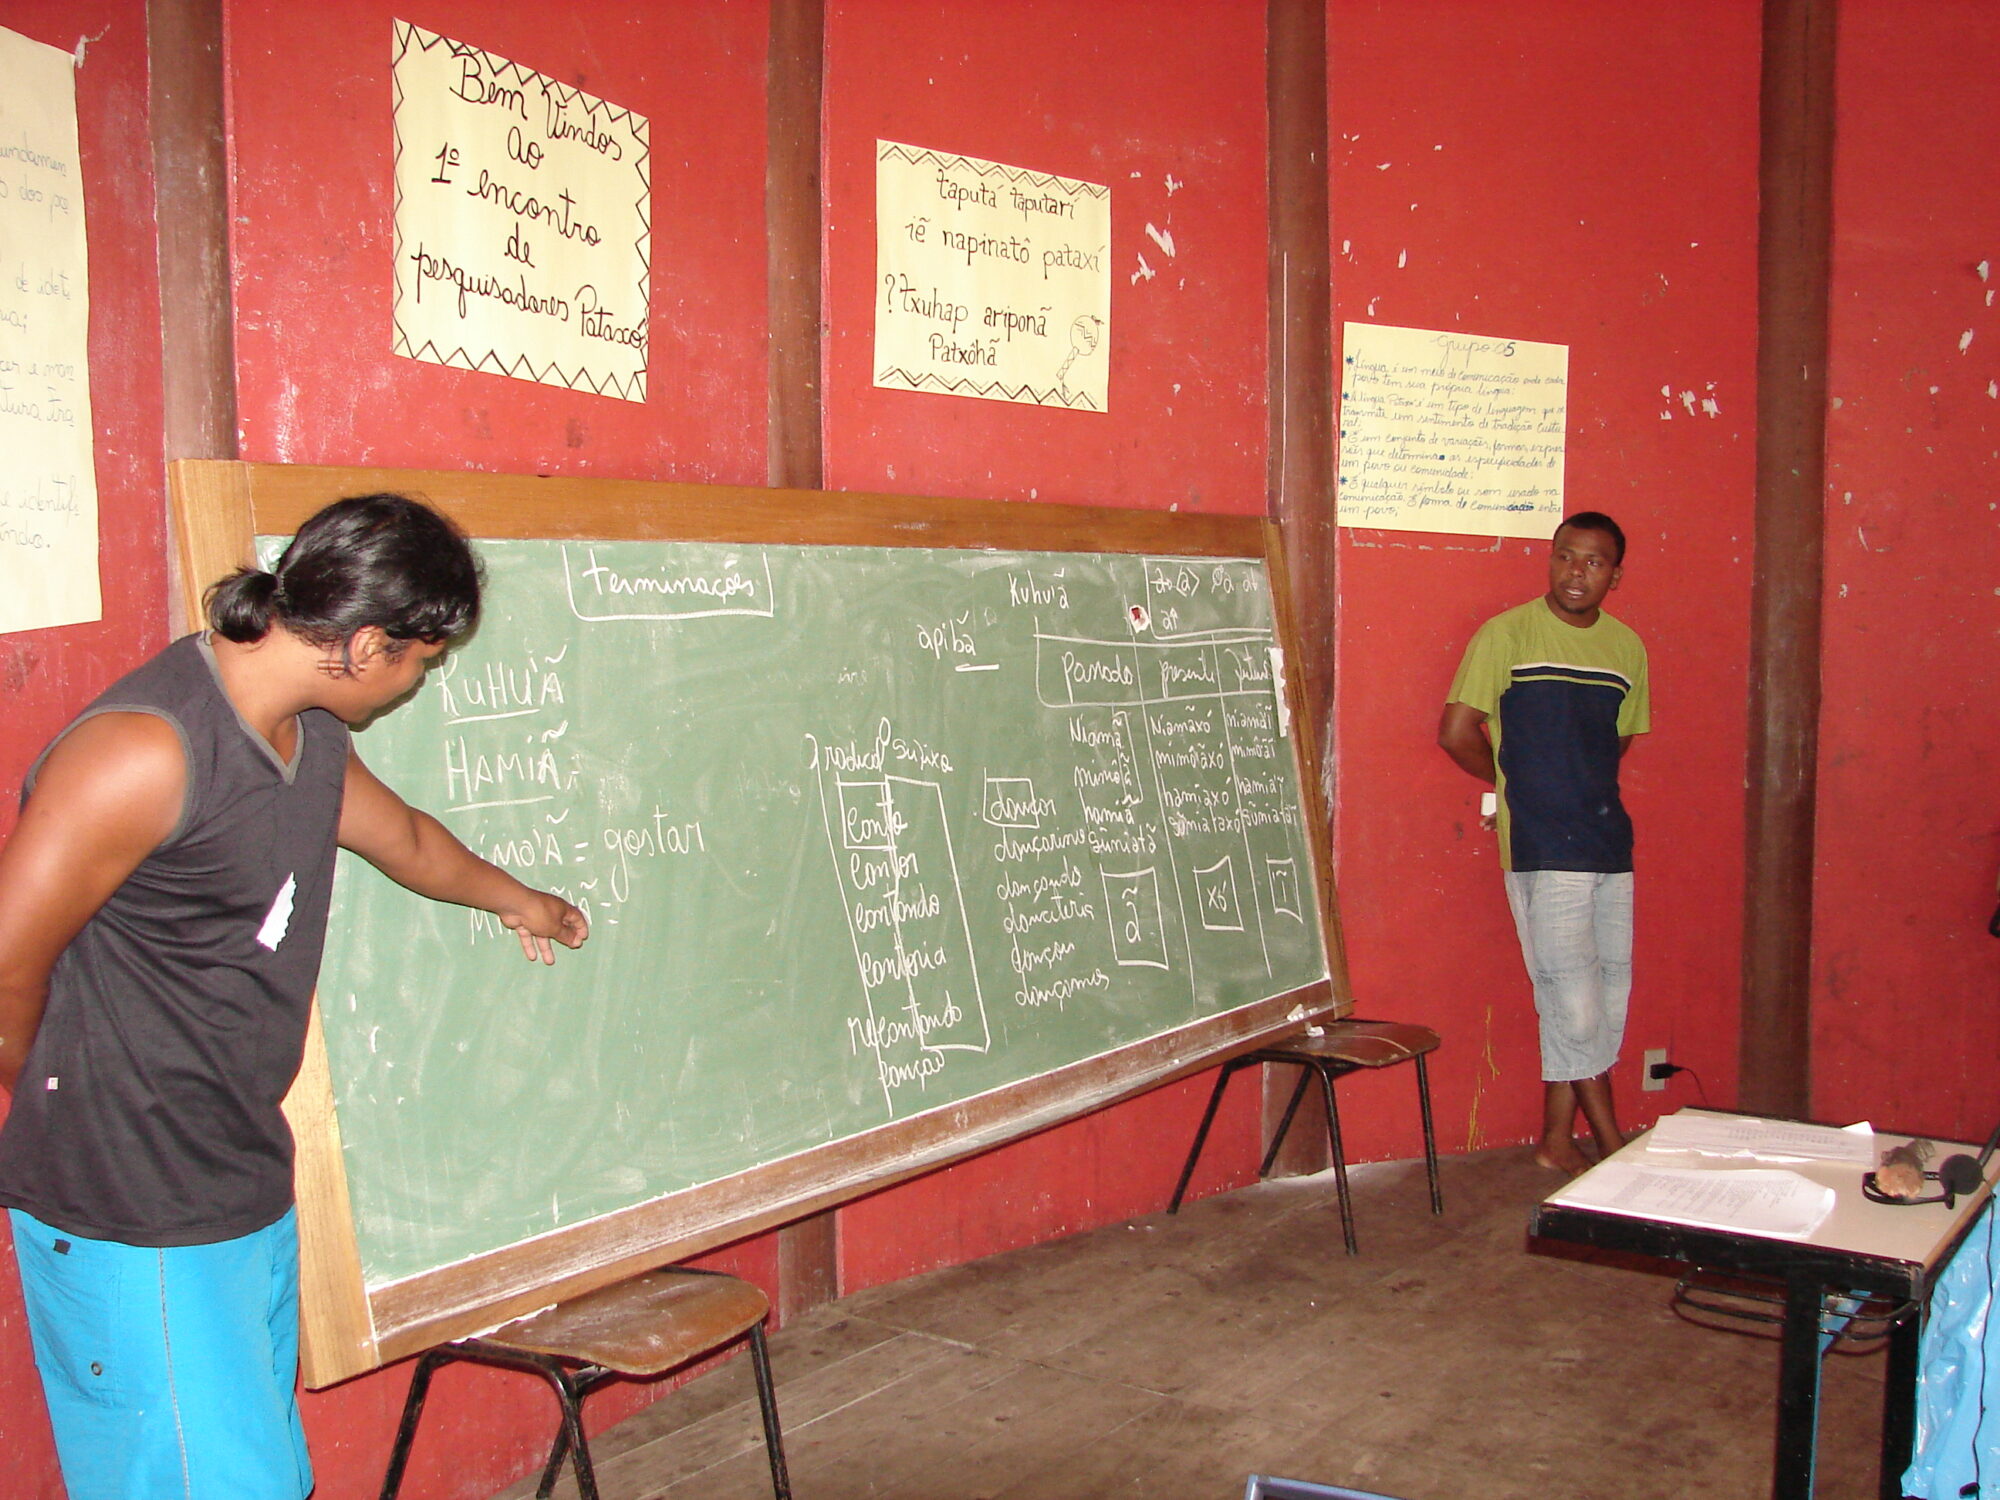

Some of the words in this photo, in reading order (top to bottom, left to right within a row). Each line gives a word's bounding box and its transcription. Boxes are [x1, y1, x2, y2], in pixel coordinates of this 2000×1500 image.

[449, 53, 527, 120] Bem
[541, 86, 622, 160] Vindos
[410, 241, 569, 319] pesquisadores
[504, 221, 535, 269] de
[603, 804, 705, 903] gostar
